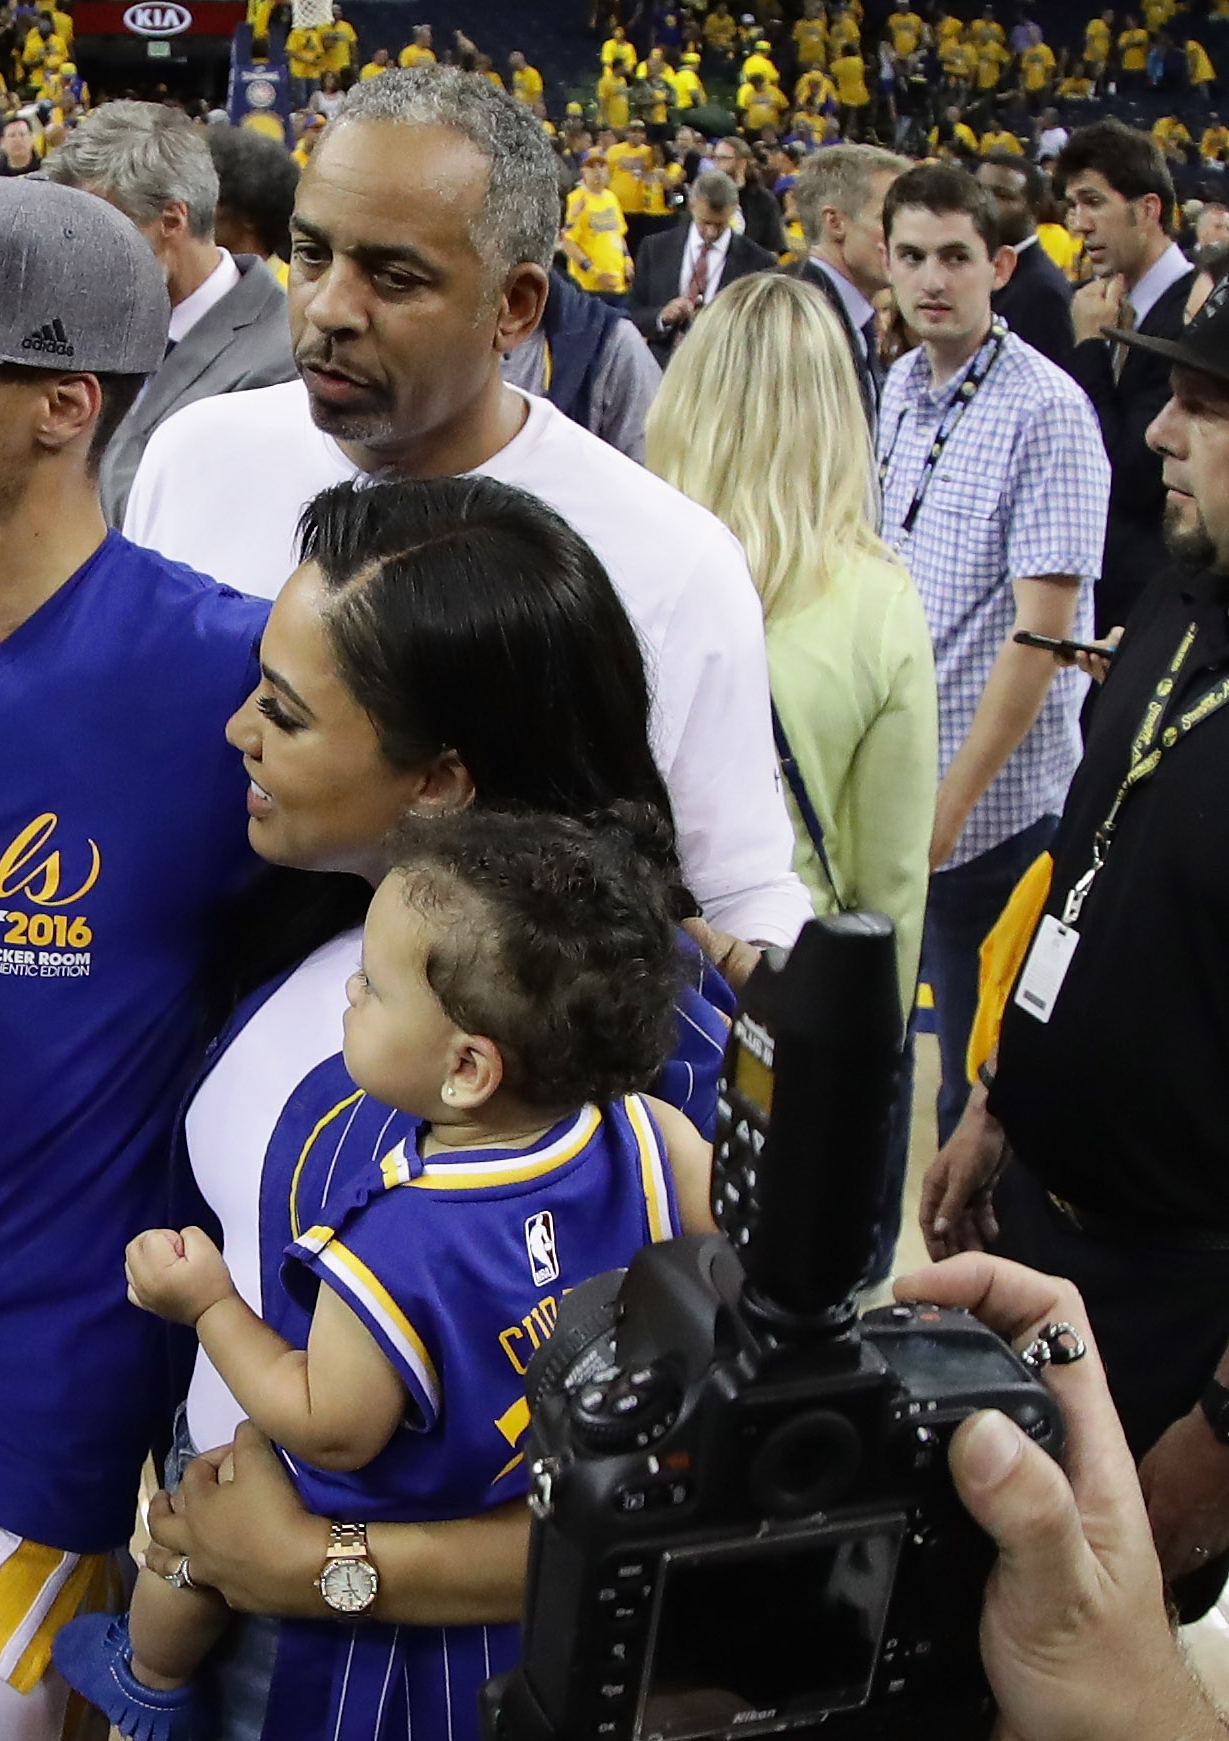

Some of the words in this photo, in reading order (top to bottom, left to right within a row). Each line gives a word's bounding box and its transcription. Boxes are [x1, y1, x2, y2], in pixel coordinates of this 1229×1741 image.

[135, 8, 181, 27] KIA
[22, 338, 74, 357] adidas
[4, 911, 92, 948] 2016
[38, 951, 91, 966] ROOM
[40, 965, 90, 977] EDITION
[733, 1708, 777, 1724] Nikon
